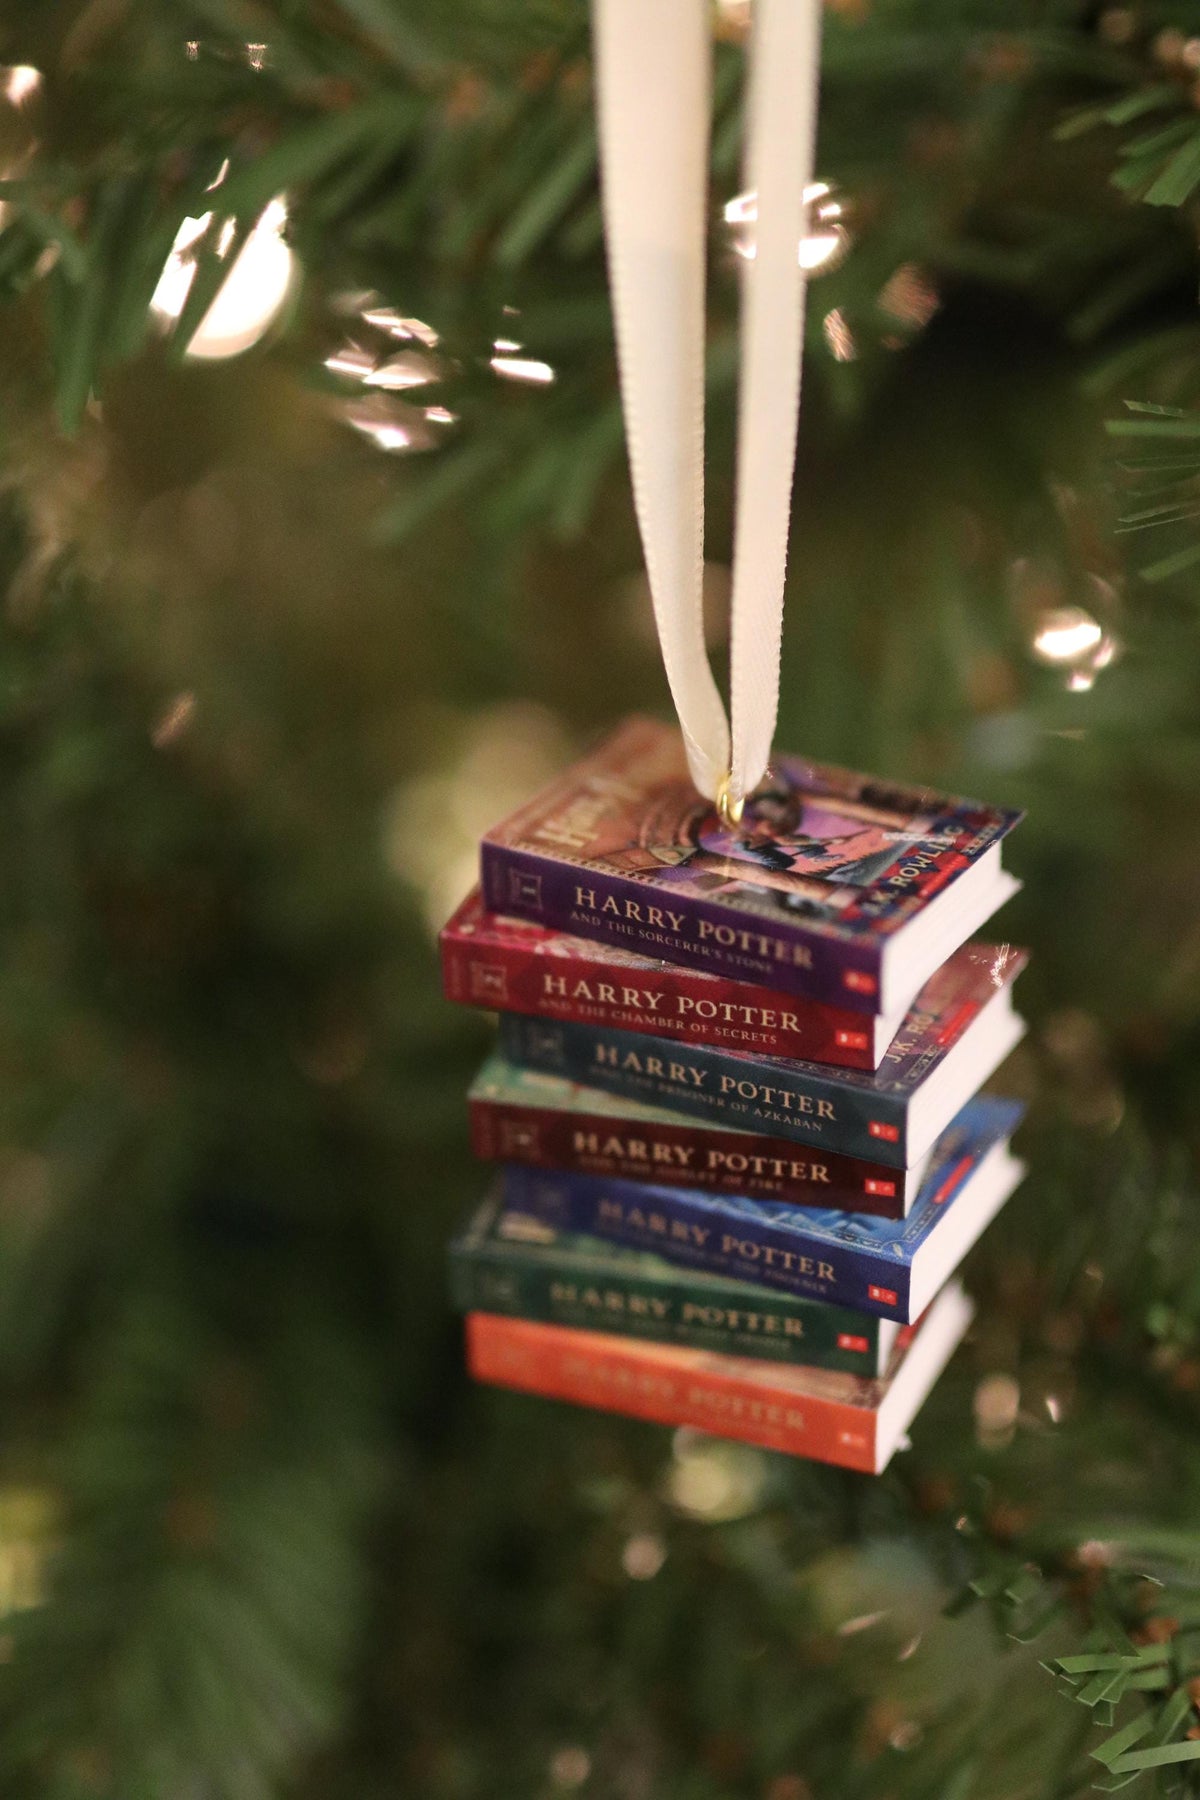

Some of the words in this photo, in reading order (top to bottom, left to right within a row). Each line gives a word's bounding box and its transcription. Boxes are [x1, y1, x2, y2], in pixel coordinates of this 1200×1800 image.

[570, 911, 600, 926] AND
[607, 920, 636, 936] THE
[638, 929, 722, 960] SORCERER'S
[727, 949, 773, 973] STONE
[575, 887, 687, 931] HARRY
[698, 919, 814, 969] POTTER
[540, 998, 572, 1012] AND
[578, 1004, 607, 1018] THE
[611, 1010, 685, 1030] CHAMBER
[690, 1022, 709, 1034] OF
[715, 1027, 777, 1045] SECRETS
[544, 974, 664, 1010] HARRY
[678, 996, 801, 1032] POTTER
[596, 1043, 708, 1086] HARRY
[720, 1075, 837, 1120] POTTER
[659, 1082, 725, 1107] PRISONER
[731, 1101, 749, 1113] OF
[754, 1107, 823, 1132] AZKABAN
[574, 1131, 695, 1165] HARRY
[707, 1150, 831, 1183] POTTER
[600, 1199, 710, 1245] HARRY
[722, 1234, 837, 1282] POTTER
[552, 1281, 669, 1318] HARRY
[682, 1302, 804, 1338] POTTER
